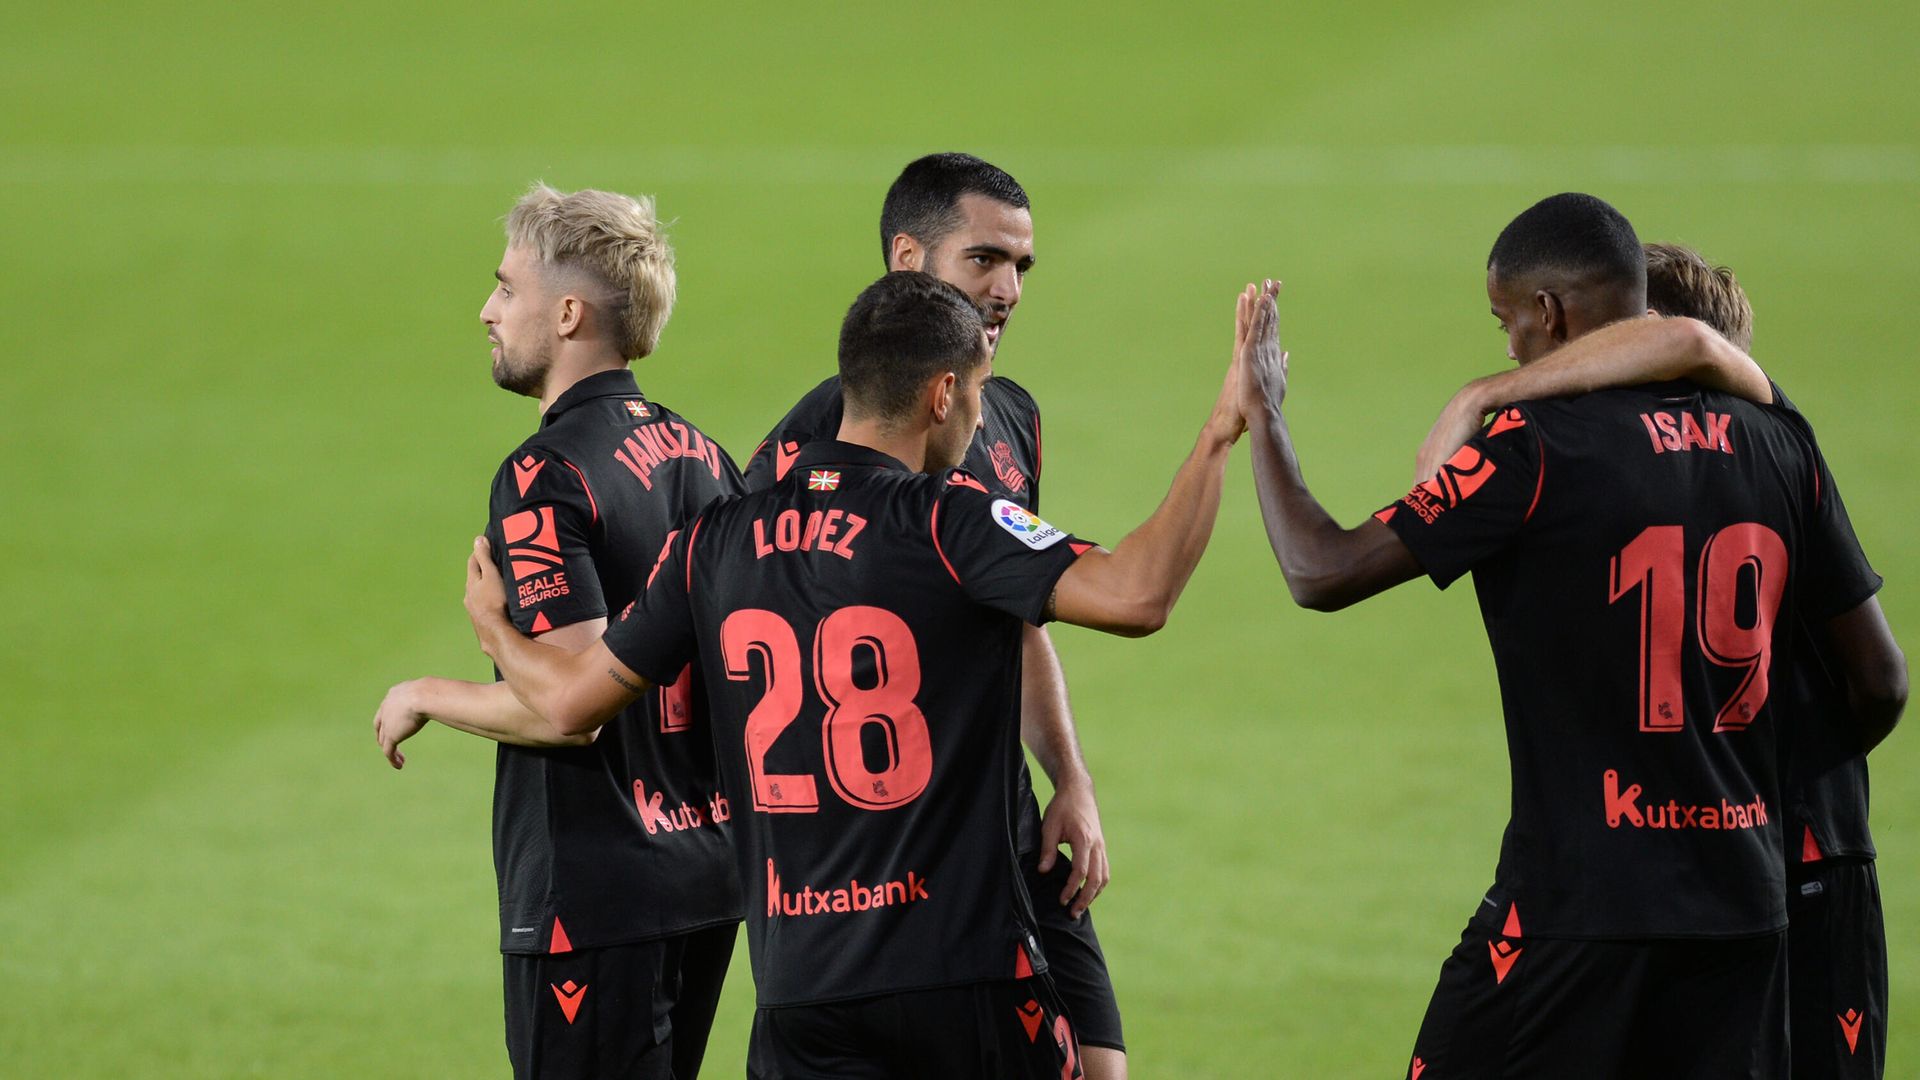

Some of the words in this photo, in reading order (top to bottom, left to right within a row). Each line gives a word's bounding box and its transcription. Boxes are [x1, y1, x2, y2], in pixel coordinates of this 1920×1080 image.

[1640, 411, 1734, 454] ISAK
[614, 421, 720, 491] JANUZAJ
[1403, 495, 1435, 525] UROS
[1408, 486, 1445, 518] EALE
[753, 509, 868, 559] LOPEZ
[1026, 527, 1060, 545] LaLiga
[518, 572, 567, 599] REALE
[519, 585, 570, 609] SEGUROS
[1609, 522, 1789, 733] 19
[720, 605, 933, 813] 28
